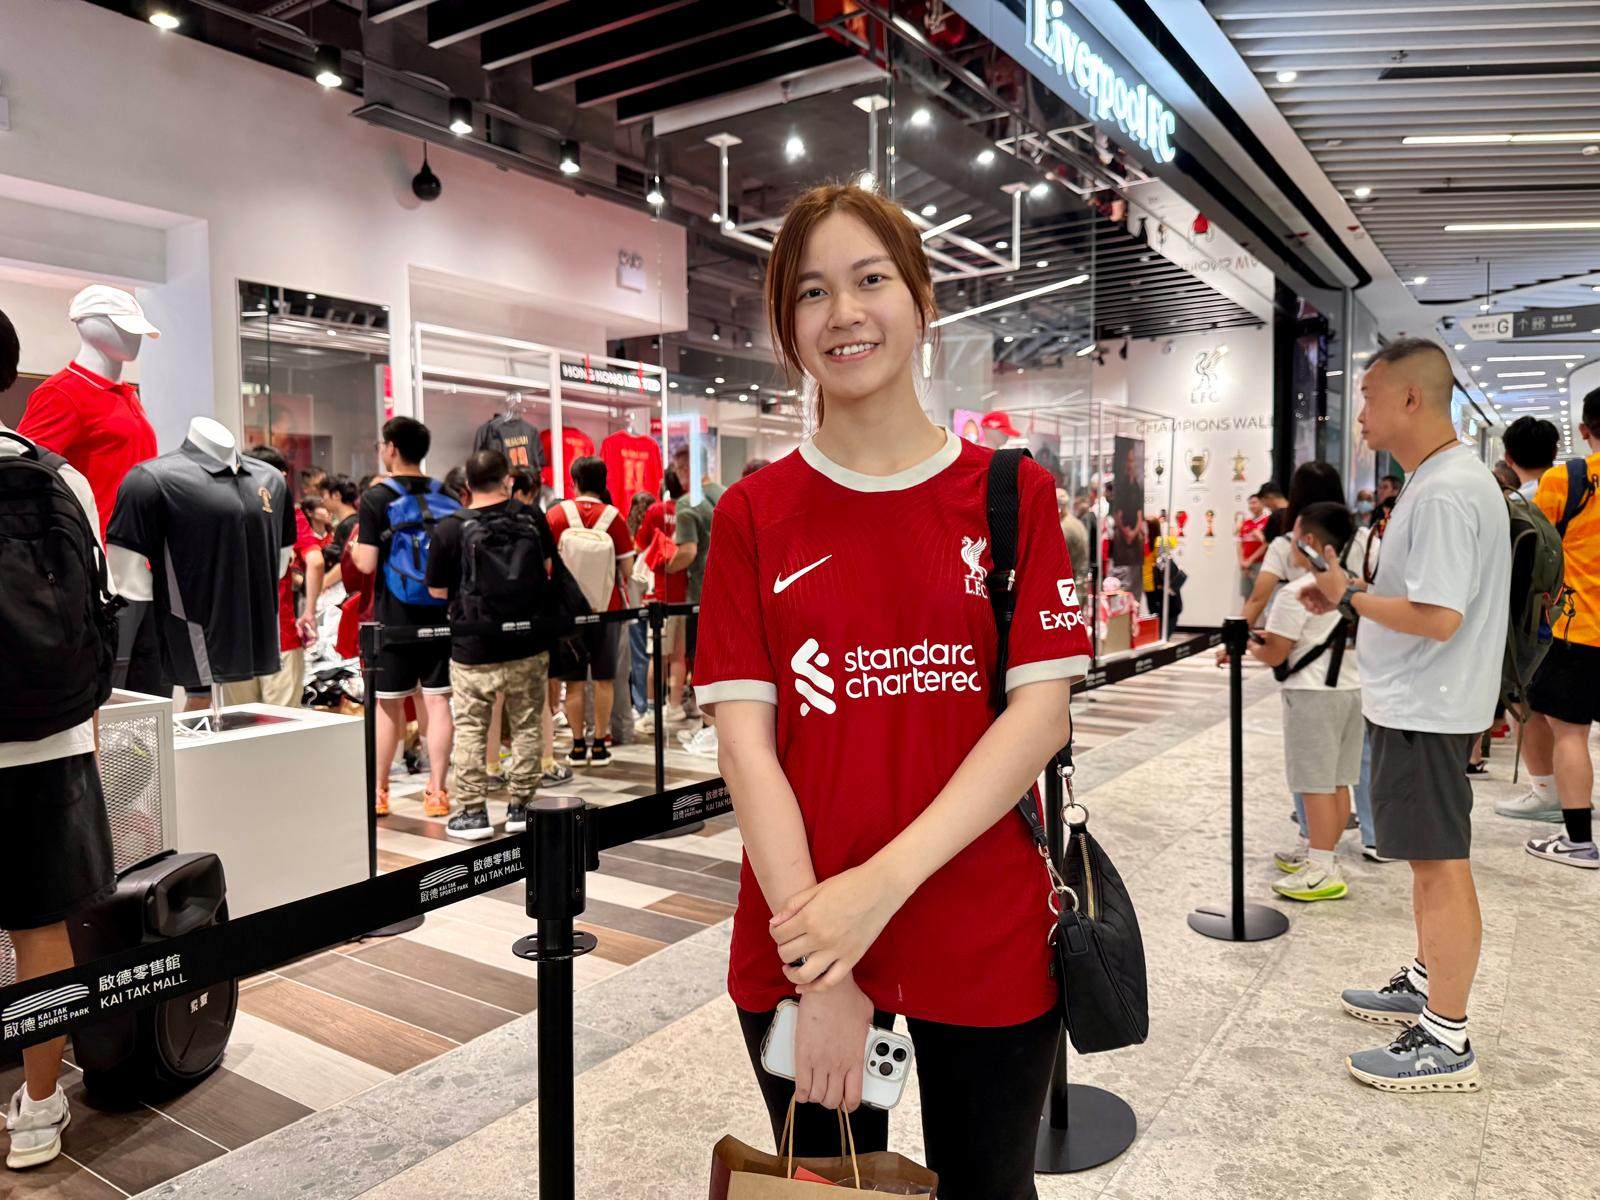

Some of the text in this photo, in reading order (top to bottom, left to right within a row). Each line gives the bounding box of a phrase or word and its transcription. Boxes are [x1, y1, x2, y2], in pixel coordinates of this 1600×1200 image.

[1029, 0, 1176, 163] Liverpool FC
[1497, 318, 1509, 334] G
[623, 374, 661, 392] LIMTED
[448, 881, 457, 889] TAK
[474, 862, 525, 886] KAI TAK MALL
[439, 883, 469, 898] SPORTS PARK
[98, 953, 181, 992] 啟德零售館
[100, 973, 188, 1009] KAI TAK MALL
[37, 1006, 68, 1021] KAI TAK
[37, 1006, 90, 1029] SPORTS PARK
[3, 1017, 36, 1039] 啟德
